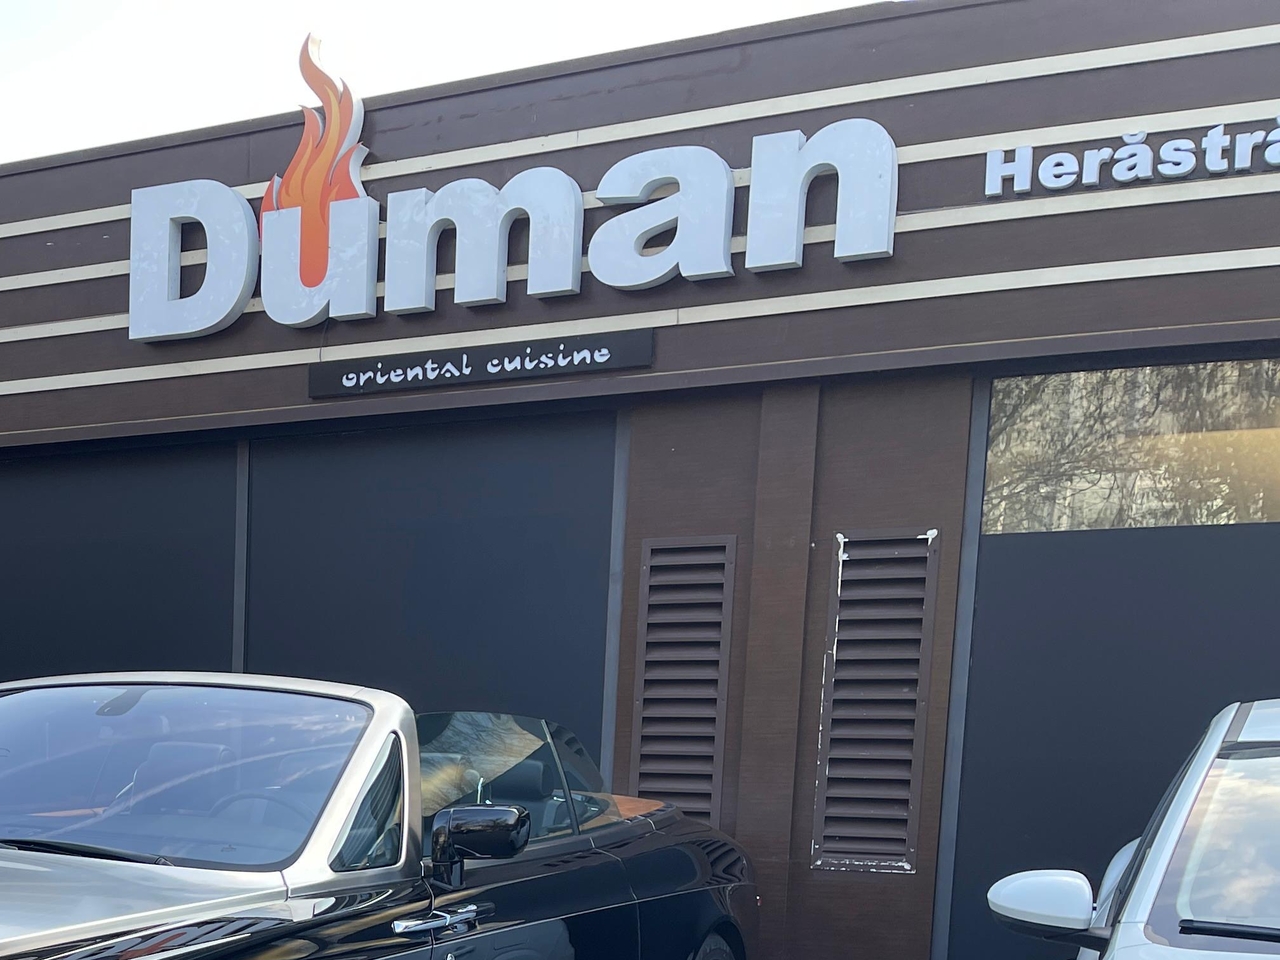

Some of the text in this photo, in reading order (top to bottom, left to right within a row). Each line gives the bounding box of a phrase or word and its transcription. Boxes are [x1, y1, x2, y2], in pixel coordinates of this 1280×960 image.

[129, 118, 898, 343] Duman
[341, 344, 611, 387] oriental cuisine
